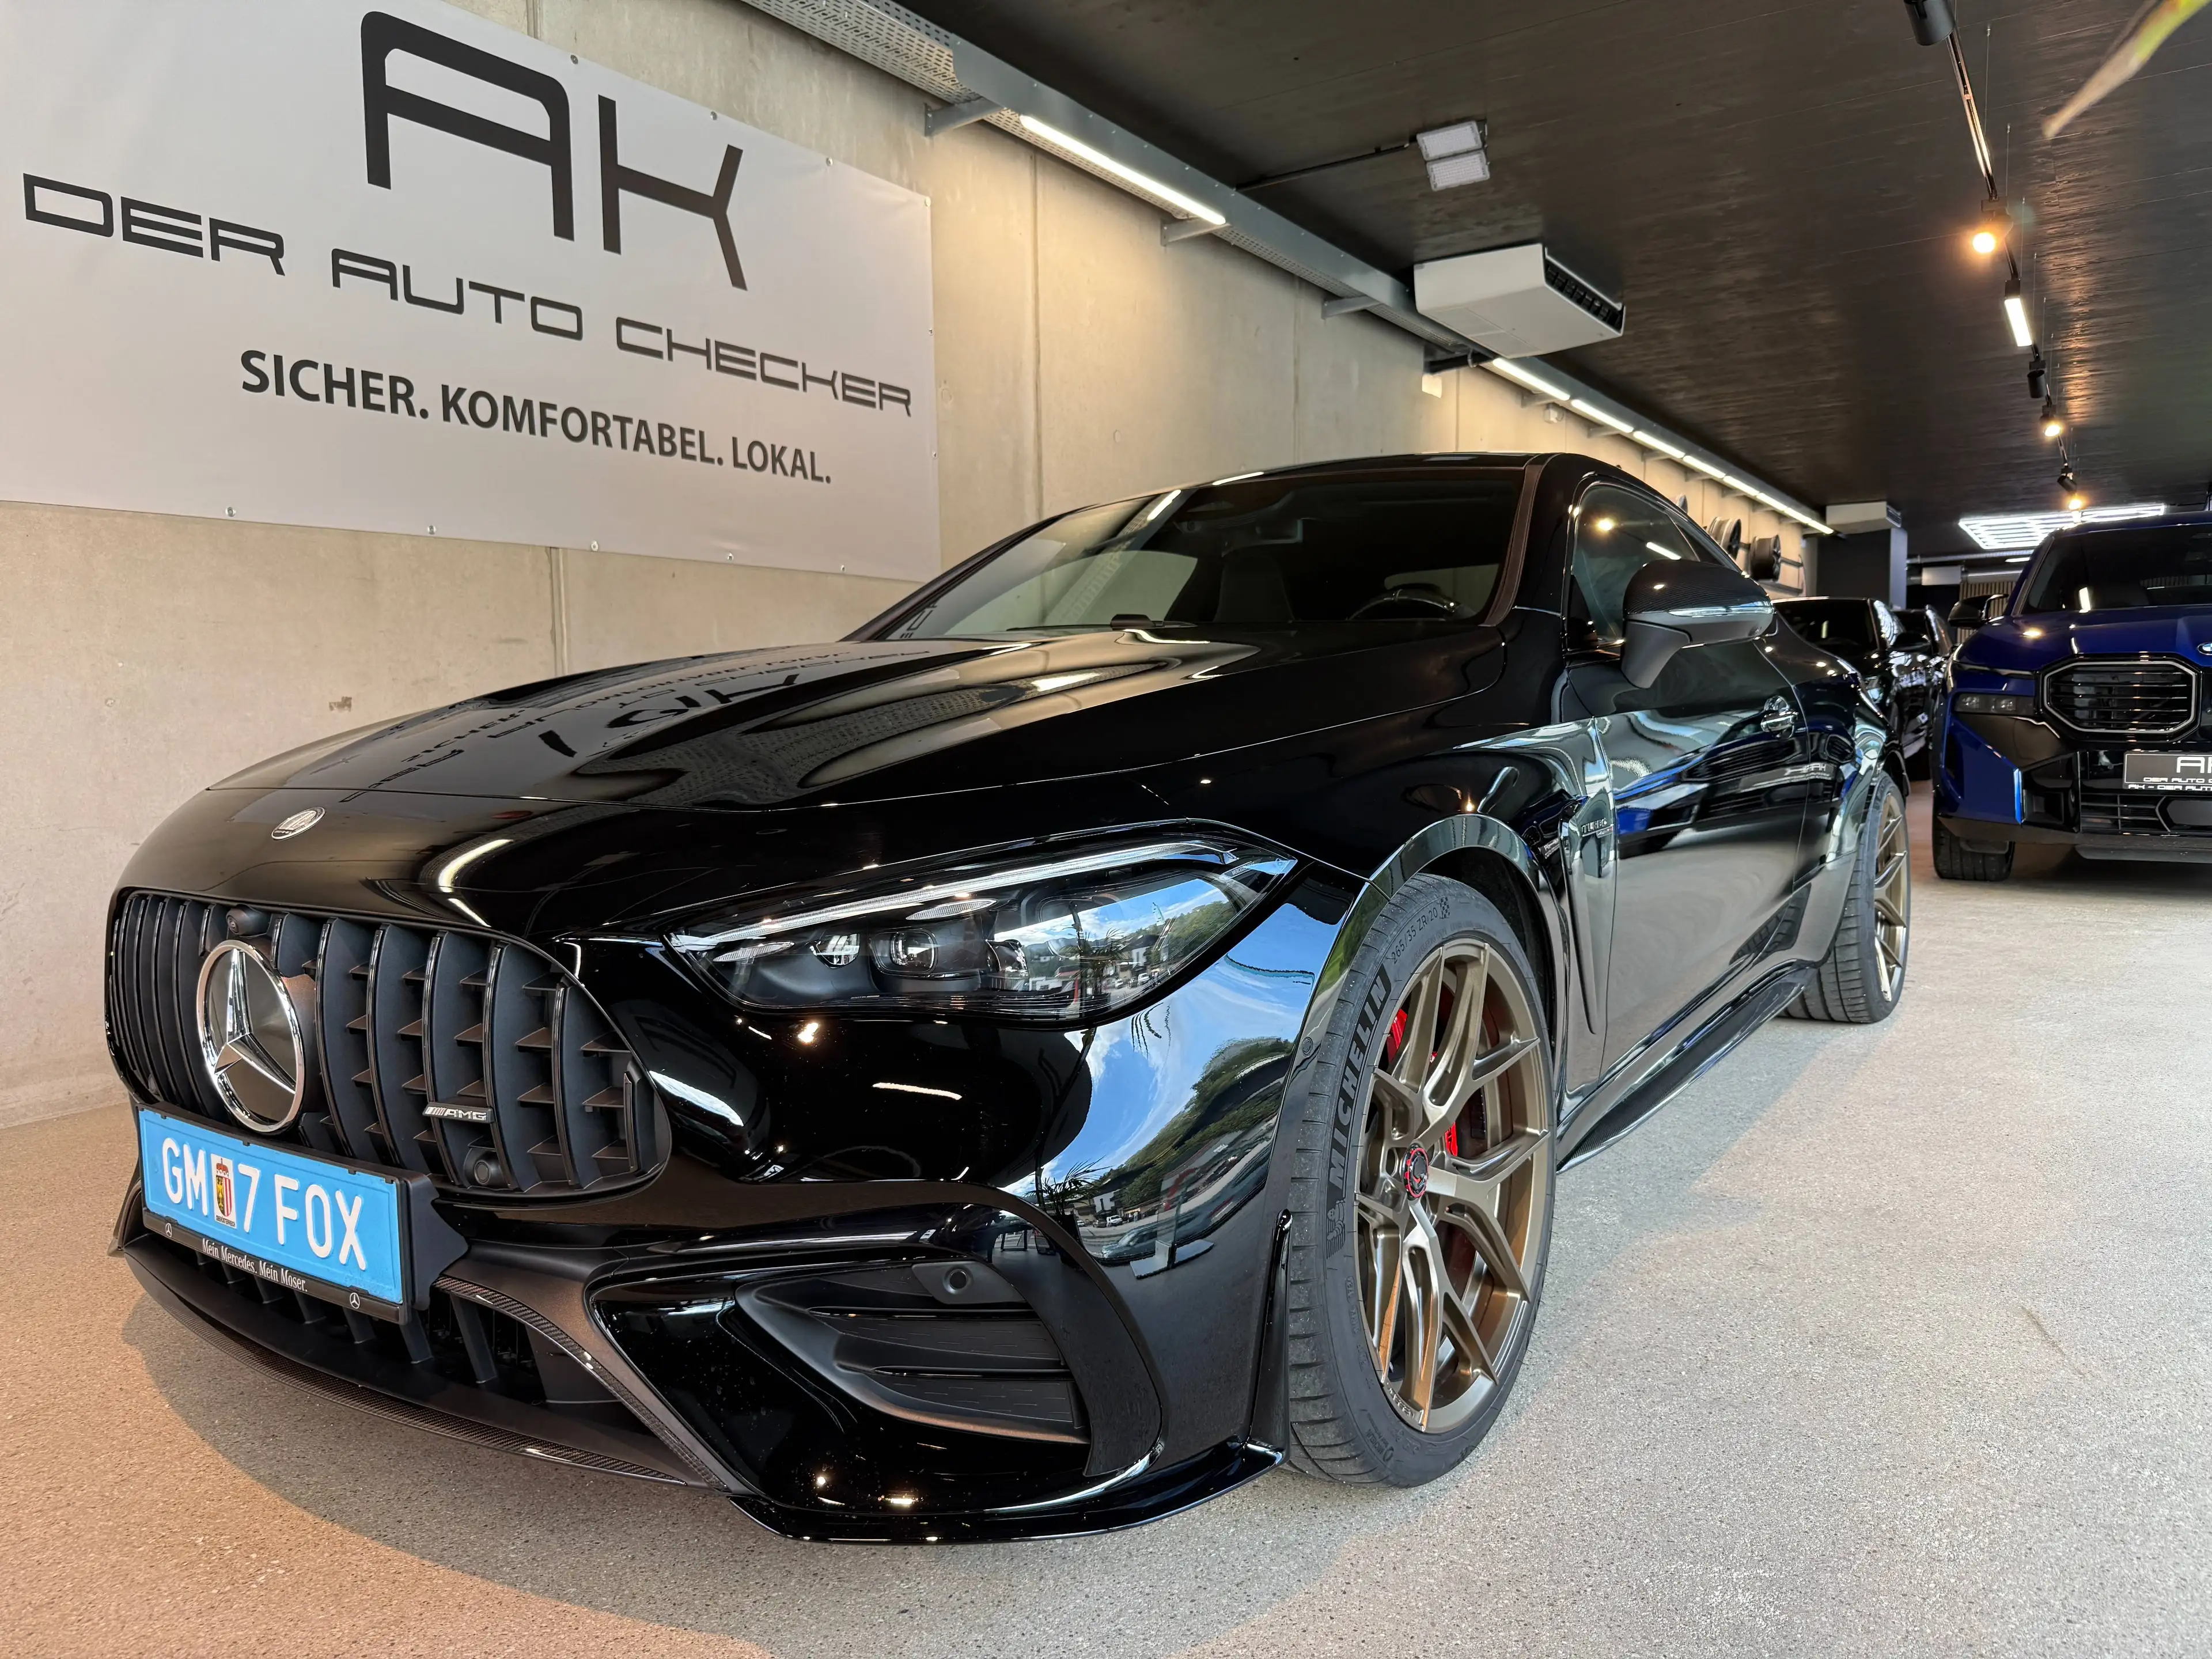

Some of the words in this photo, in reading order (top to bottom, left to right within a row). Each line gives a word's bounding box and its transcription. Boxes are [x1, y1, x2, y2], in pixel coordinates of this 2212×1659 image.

[361, 12, 747, 290] AK
[23, 173, 285, 276] DER
[332, 249, 582, 340] AUTO
[616, 317, 910, 416] CHECKER
[241, 350, 429, 419] SICHER.
[442, 384, 723, 465] KOMFORTABEL.
[733, 437, 831, 483] LOKAL.
[2176, 756, 2212, 773] A
[1417, 915, 1428, 931] ZR
[1429, 908, 1438, 922] 20
[1330, 975, 1387, 1190] MICHELIN
[162, 1138, 207, 1215] GM
[275, 1175, 366, 1270] FOX
[202, 1238, 219, 1259] Mein
[221, 1245, 257, 1274] Mercedes.
[259, 1260, 279, 1282] Mein
[281, 1268, 308, 1292] Moser.
